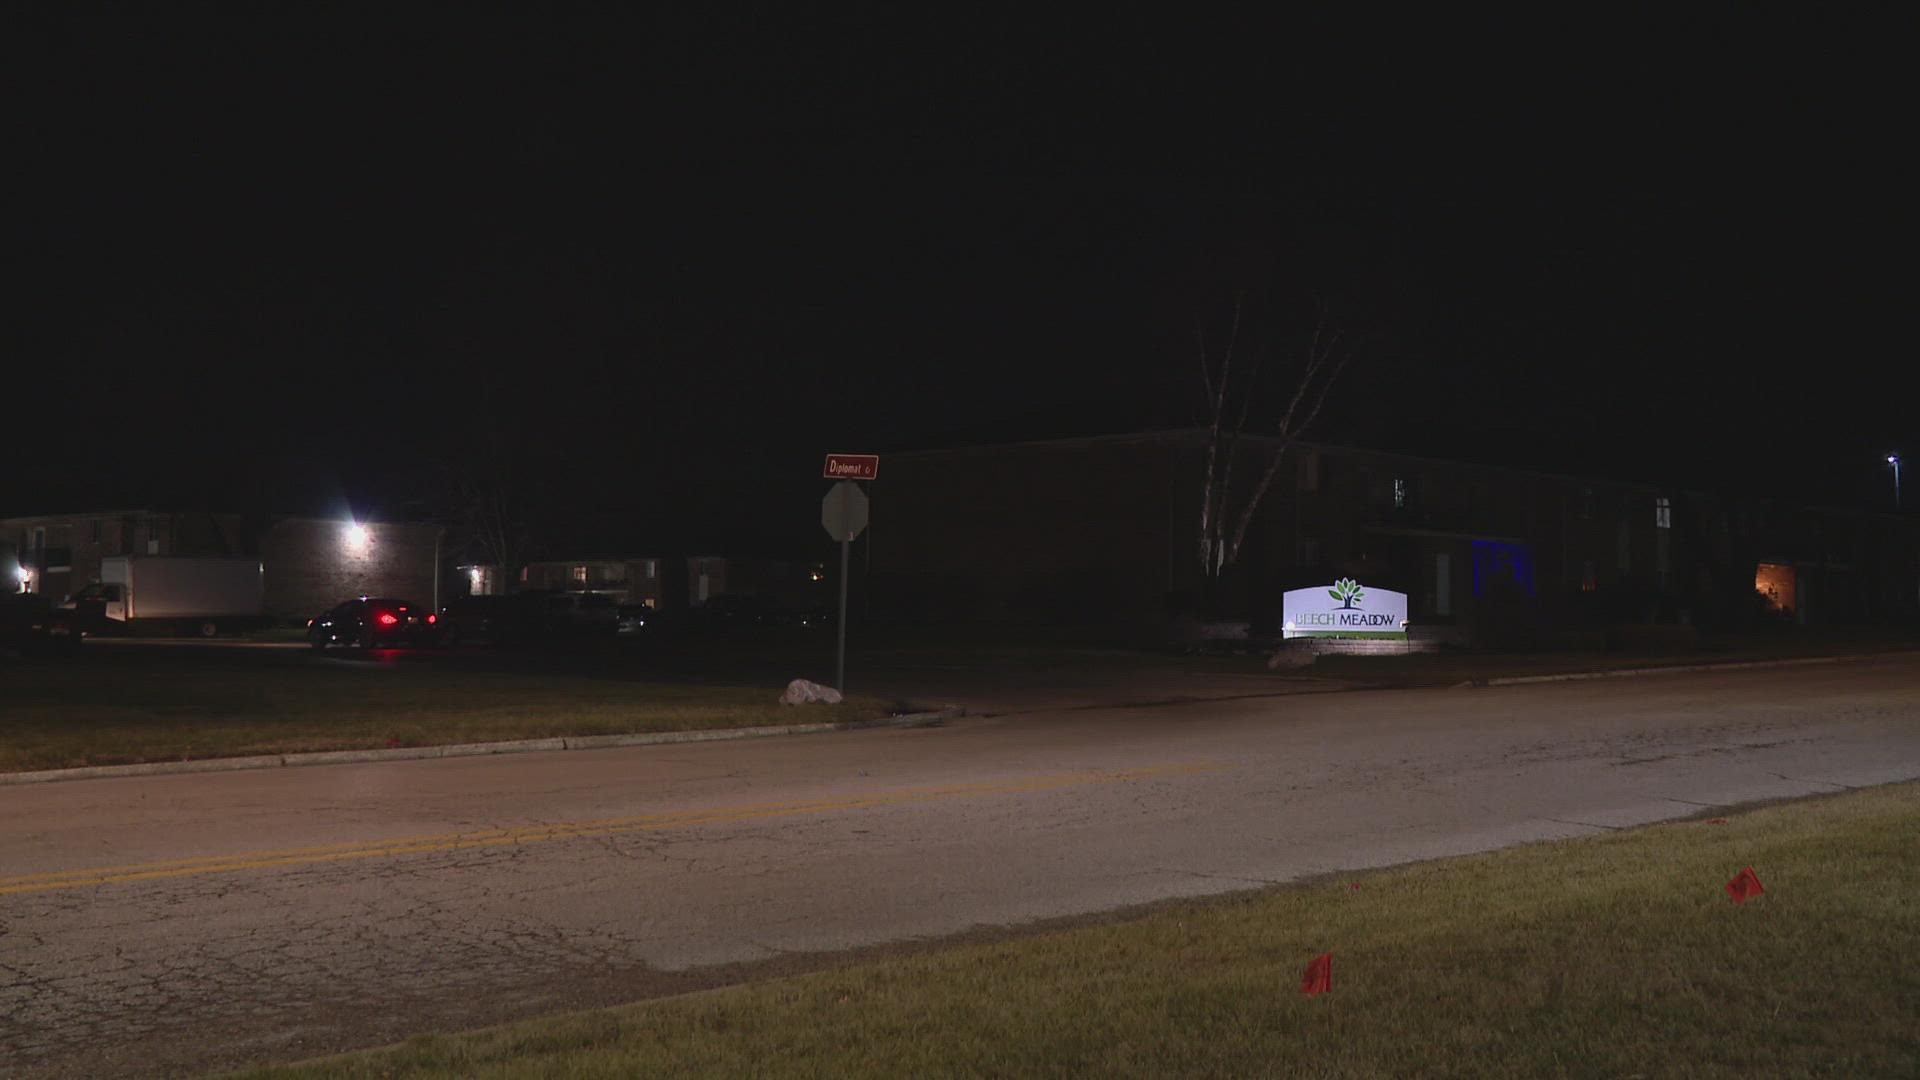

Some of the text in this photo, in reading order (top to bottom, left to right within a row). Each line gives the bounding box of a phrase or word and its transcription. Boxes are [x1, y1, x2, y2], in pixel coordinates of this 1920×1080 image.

[830, 459, 861, 475] Diplomat
[1295, 613, 1395, 626] BEECH MEADOW
